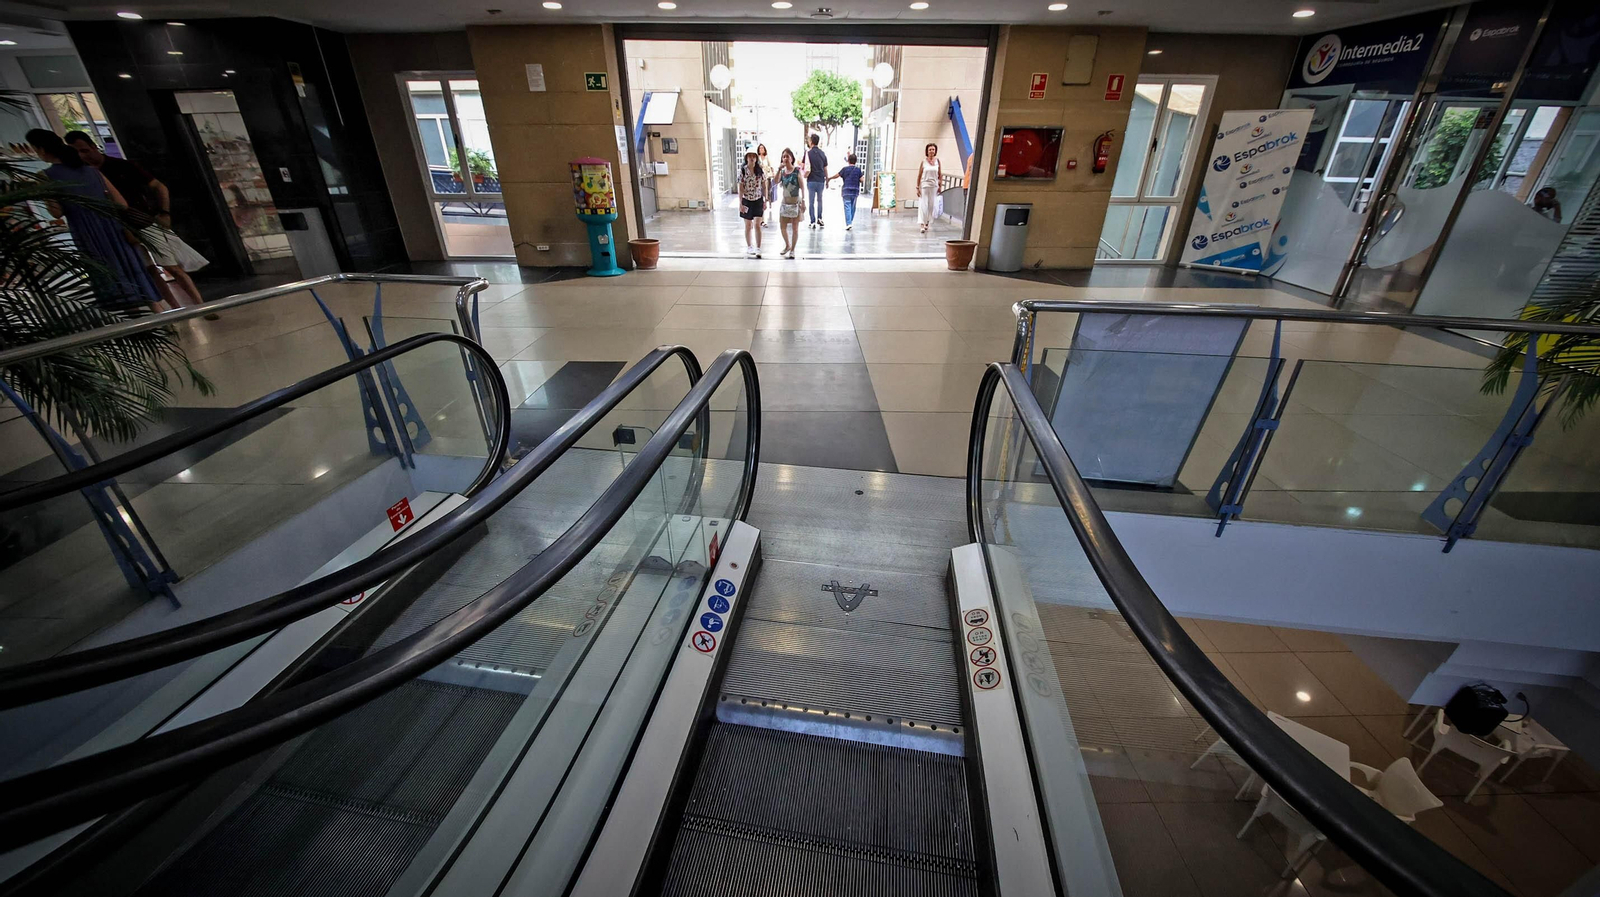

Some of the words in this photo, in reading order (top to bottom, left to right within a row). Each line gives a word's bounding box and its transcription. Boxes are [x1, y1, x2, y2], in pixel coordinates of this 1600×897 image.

[1339, 32, 1424, 61] Intermedia2
[1234, 131, 1298, 163] Espabrok
[1211, 218, 1270, 243] Espabrok
